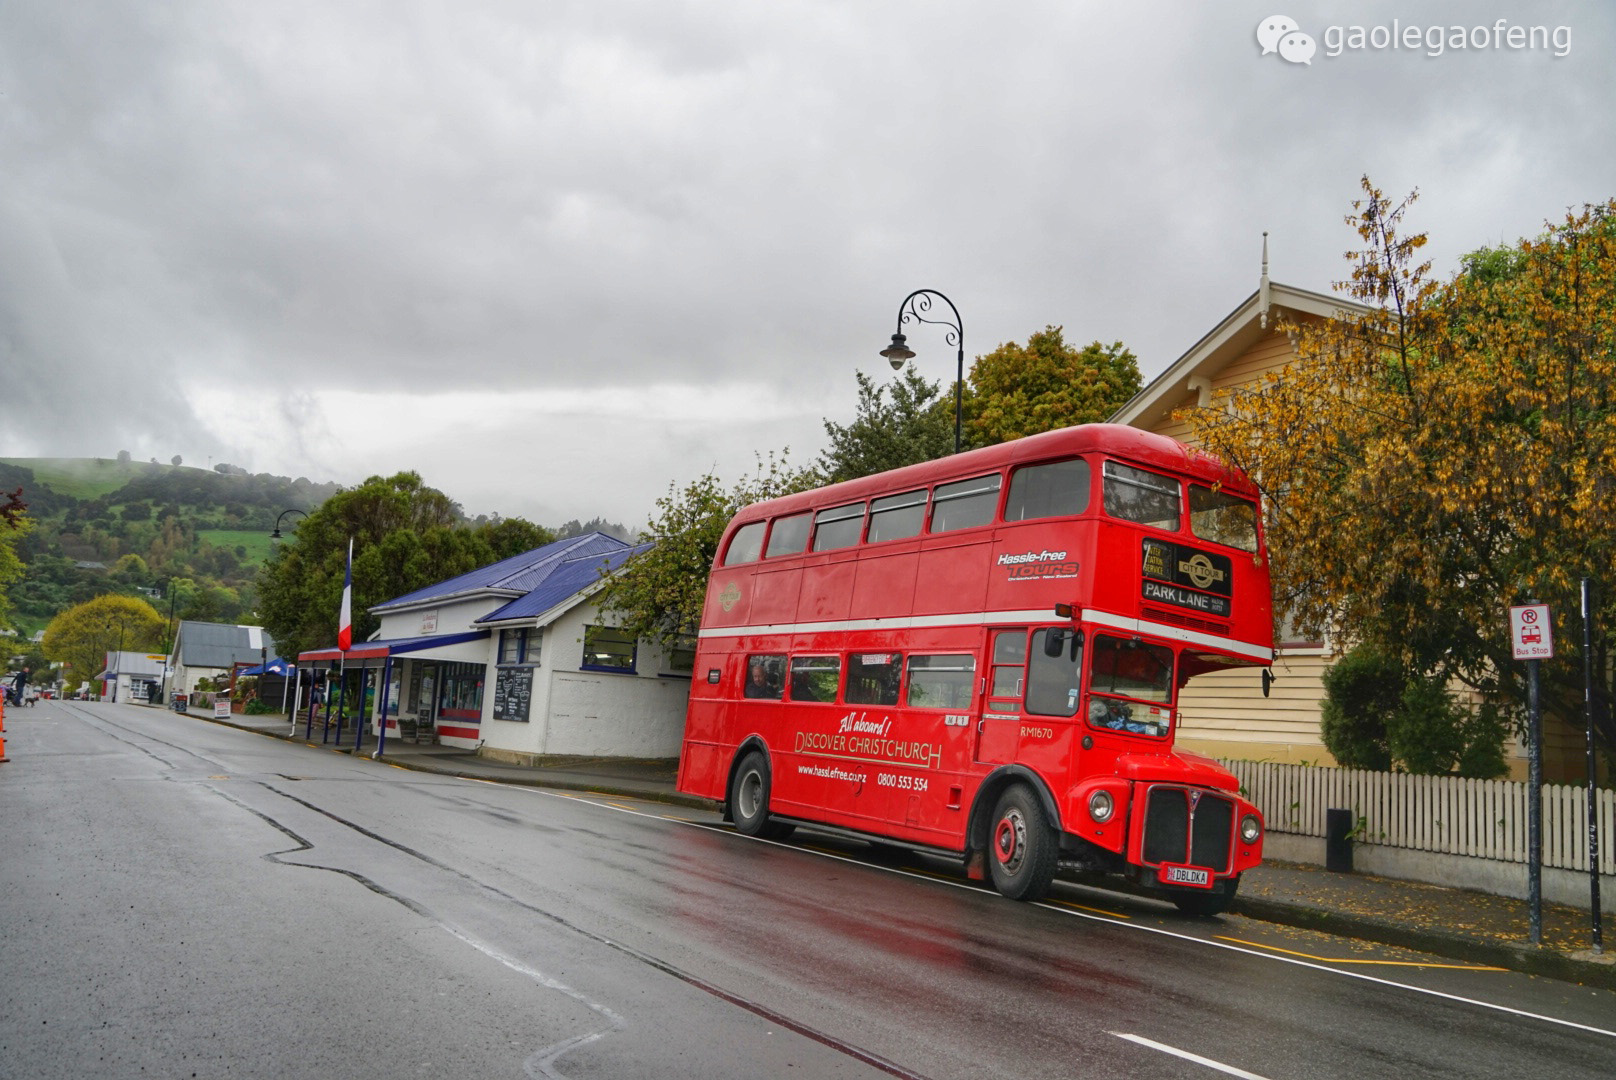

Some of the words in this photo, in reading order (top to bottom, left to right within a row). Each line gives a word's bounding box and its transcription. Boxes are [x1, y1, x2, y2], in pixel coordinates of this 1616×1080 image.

[997, 550, 1067, 565] Hassle-free
[1007, 562, 1079, 577] Tours
[1182, 563, 1198, 573] CITY
[1200, 568, 1220, 578] TOUR
[1145, 583, 1176, 601] PARK
[1178, 591, 1209, 609] LANE
[1531, 647, 1549, 655] Stop
[1020, 726, 1053, 739] RM1670
[794, 731, 846, 753] DISCOVER
[848, 736, 942, 769] CHRISTCHURCH
[798, 764, 867, 783] www.hasslefree.co.nz
[877, 773, 896, 787] 0800
[897, 775, 912, 790] 553
[913, 778, 929, 792] 554
[1176, 869, 1206, 883] DBLDKA
